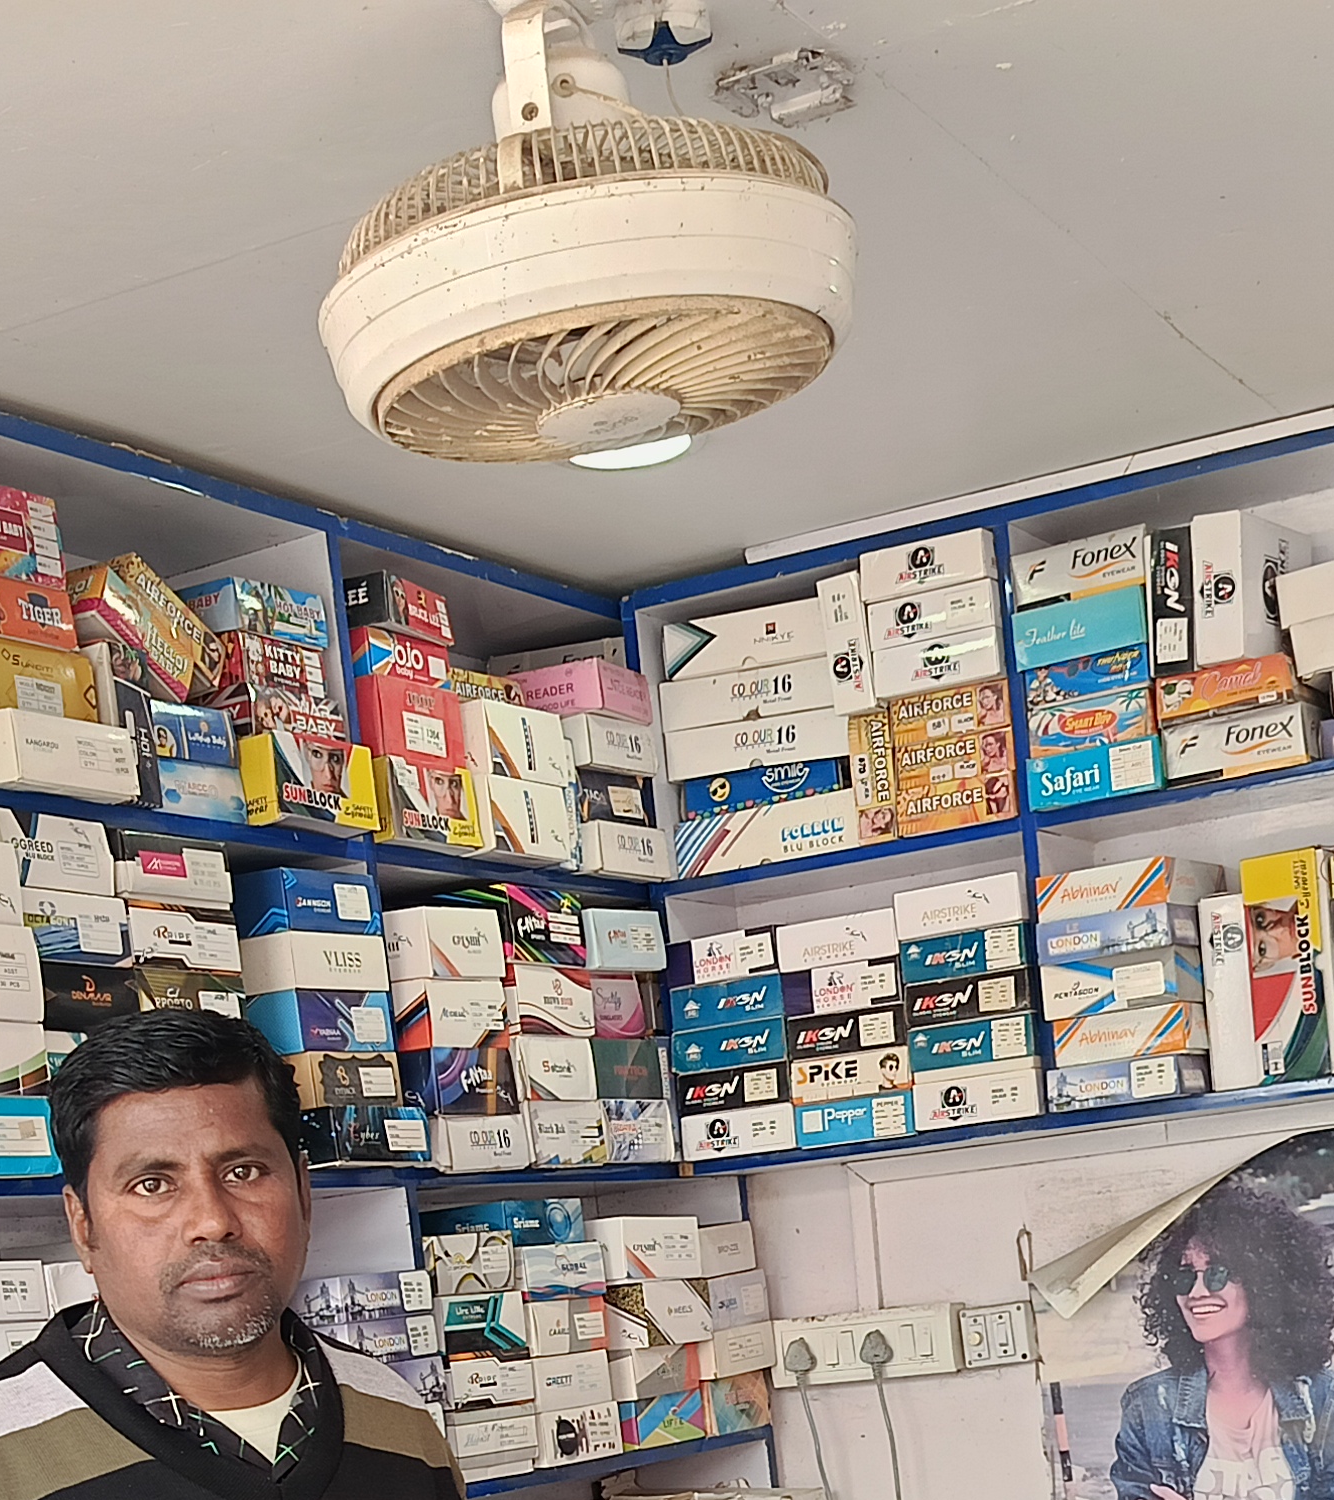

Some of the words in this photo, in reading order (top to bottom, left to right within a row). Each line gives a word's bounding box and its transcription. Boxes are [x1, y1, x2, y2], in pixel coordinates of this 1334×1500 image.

[4, 520, 24, 540] BABY
[1071, 535, 1138, 573] Fonex
[896, 564, 944, 584] AIRSTRIKE
[1102, 564, 1137, 579] EYEWEAR
[1202, 561, 1214, 619] AIRSTRIKE
[18, 598, 62, 628] TIGER
[296, 605, 321, 621] BABY
[885, 621, 932, 639] AIRSTRIKE
[1025, 625, 1066, 647] Feather
[1070, 619, 1086, 640] lite
[265, 644, 301, 664] KITTY
[269, 660, 301, 679] BABY
[912, 661, 959, 681] AIRSTRIKE
[455, 682, 505, 700] AIRFORCE
[526, 682, 574, 700] READER
[771, 674, 792, 695] 16
[898, 692, 973, 721] AIRFORCE
[295, 715, 335, 735] BABY
[775, 724, 796, 746] 16
[1224, 712, 1293, 748] Fonex
[628, 733, 641, 754] 16
[901, 739, 976, 767] AIRFORCE
[1256, 743, 1292, 757] EYEWEAR
[868, 719, 889, 802] AIRFORCE
[1041, 763, 1100, 796] Safari
[283, 782, 342, 811] SUNBLOCK
[906, 788, 983, 816] AIRFORCE
[402, 808, 450, 832] SUNBLOCK
[640, 836, 653, 857] 16
[783, 843, 803, 853] BLU
[809, 834, 845, 849] BLOCK
[1061, 880, 1119, 904] Abhinav
[921, 902, 977, 922] AIRSTRIKE
[1050, 933, 1098, 949] LONDON
[1211, 911, 1225, 966] AIRSTRIKE
[802, 940, 855, 958] AIRSTRIKE
[323, 950, 362, 969] VLISS
[694, 954, 732, 969] LONDON
[696, 963, 731, 975] HORSE
[1301, 914, 1317, 1015] SUNBLOCK
[814, 986, 854, 998] LONDON
[815, 992, 852, 1005] HORSE
[1079, 1025, 1138, 1047] Abhinav
[1079, 1079, 1124, 1093] LONDON
[824, 1108, 866, 1130] Pepper
[931, 1105, 977, 1120] AIRSTRIKE
[496, 1128, 511, 1148] 16
[697, 1136, 739, 1150] AIRSTRIKE
[561, 1262, 587, 1271] GLOBAL
[366, 1291, 398, 1304] LONDON
[374, 1336, 405, 1349] LONDON
